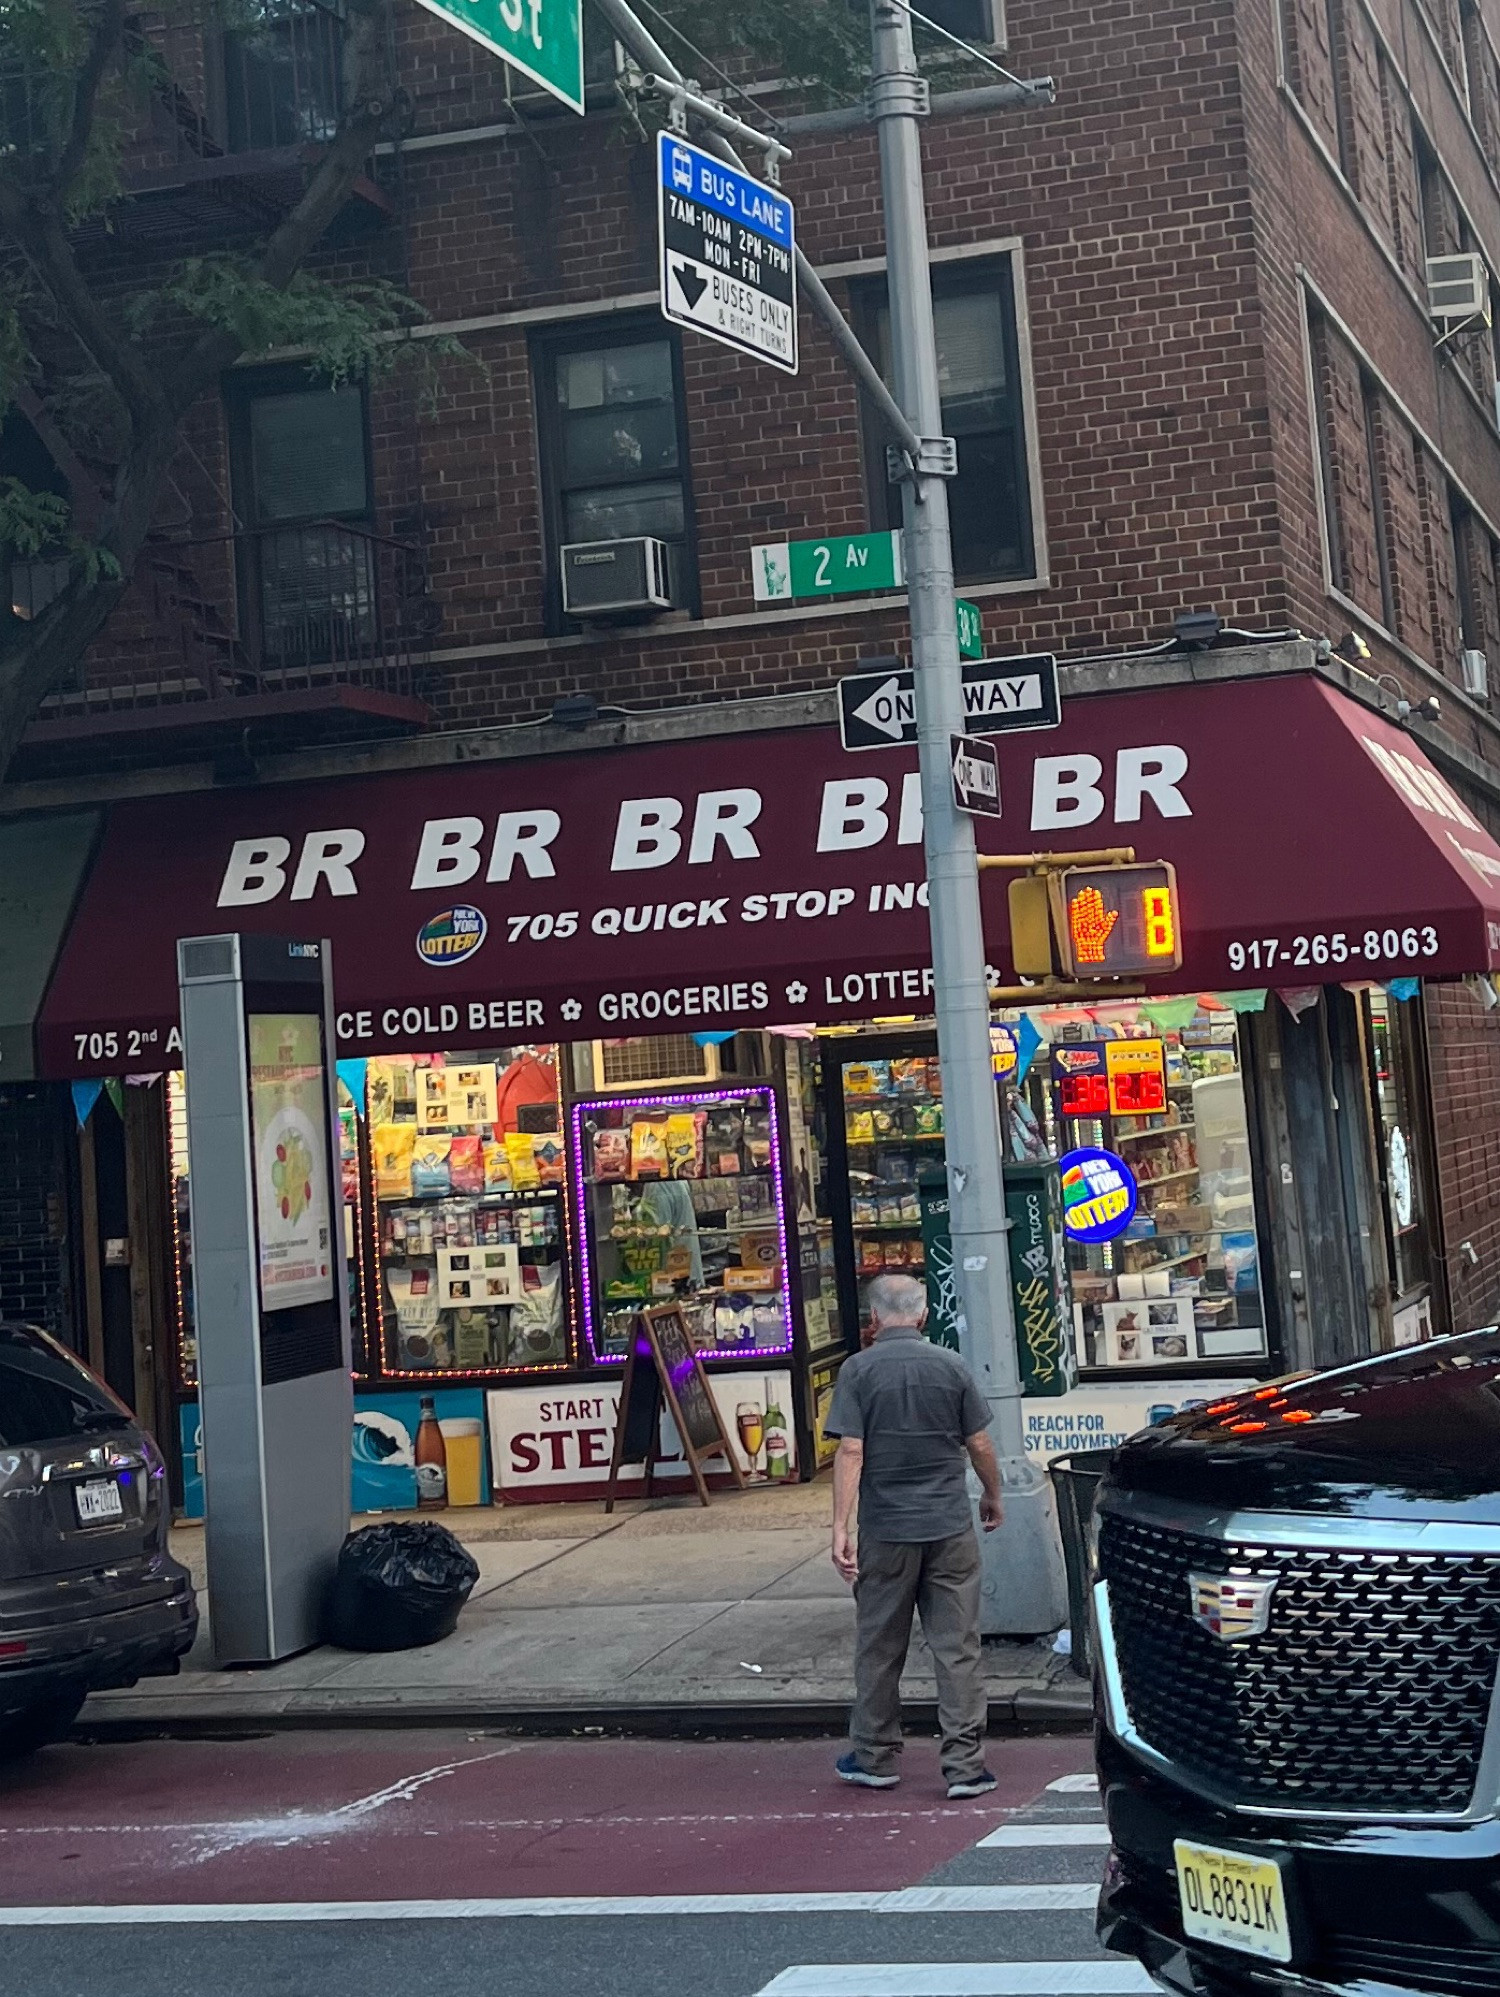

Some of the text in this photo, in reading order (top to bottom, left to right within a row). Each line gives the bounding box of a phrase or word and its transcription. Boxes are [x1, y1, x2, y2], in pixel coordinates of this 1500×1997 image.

[701, 167, 784, 234] BUS LANE
[713, 274, 789, 333] BUSES ONLY
[730, 312, 755, 339] RIGHT
[761, 327, 786, 354] TURNS
[813, 546, 832, 587] 2
[875, 680, 1027, 724] ON WAY
[216, 828, 366, 907] BR
[410, 809, 562, 890] BR
[610, 788, 763, 872] BR
[1030, 744, 1193, 832] BR
[453, 908, 480, 934] NEW YORK
[507, 911, 579, 943] 705
[591, 898, 730, 936] QUICK
[741, 888, 855, 922] STOP
[1143, 887, 1175, 957] 8
[421, 932, 481, 955] LOTTERY
[1228, 926, 1439, 972] 917-265-8063
[74, 968, 934, 1061] 705 2nd A CE COLD BEER GROCERIES LOTTER
[1081, 1159, 1111, 1178] NEW
[1087, 1170, 1124, 1195] YORK
[540, 1398, 604, 1422] START
[1028, 1414, 1104, 1432] REACH FOR
[1024, 1432, 1128, 1451] SY ENJOYMENT
